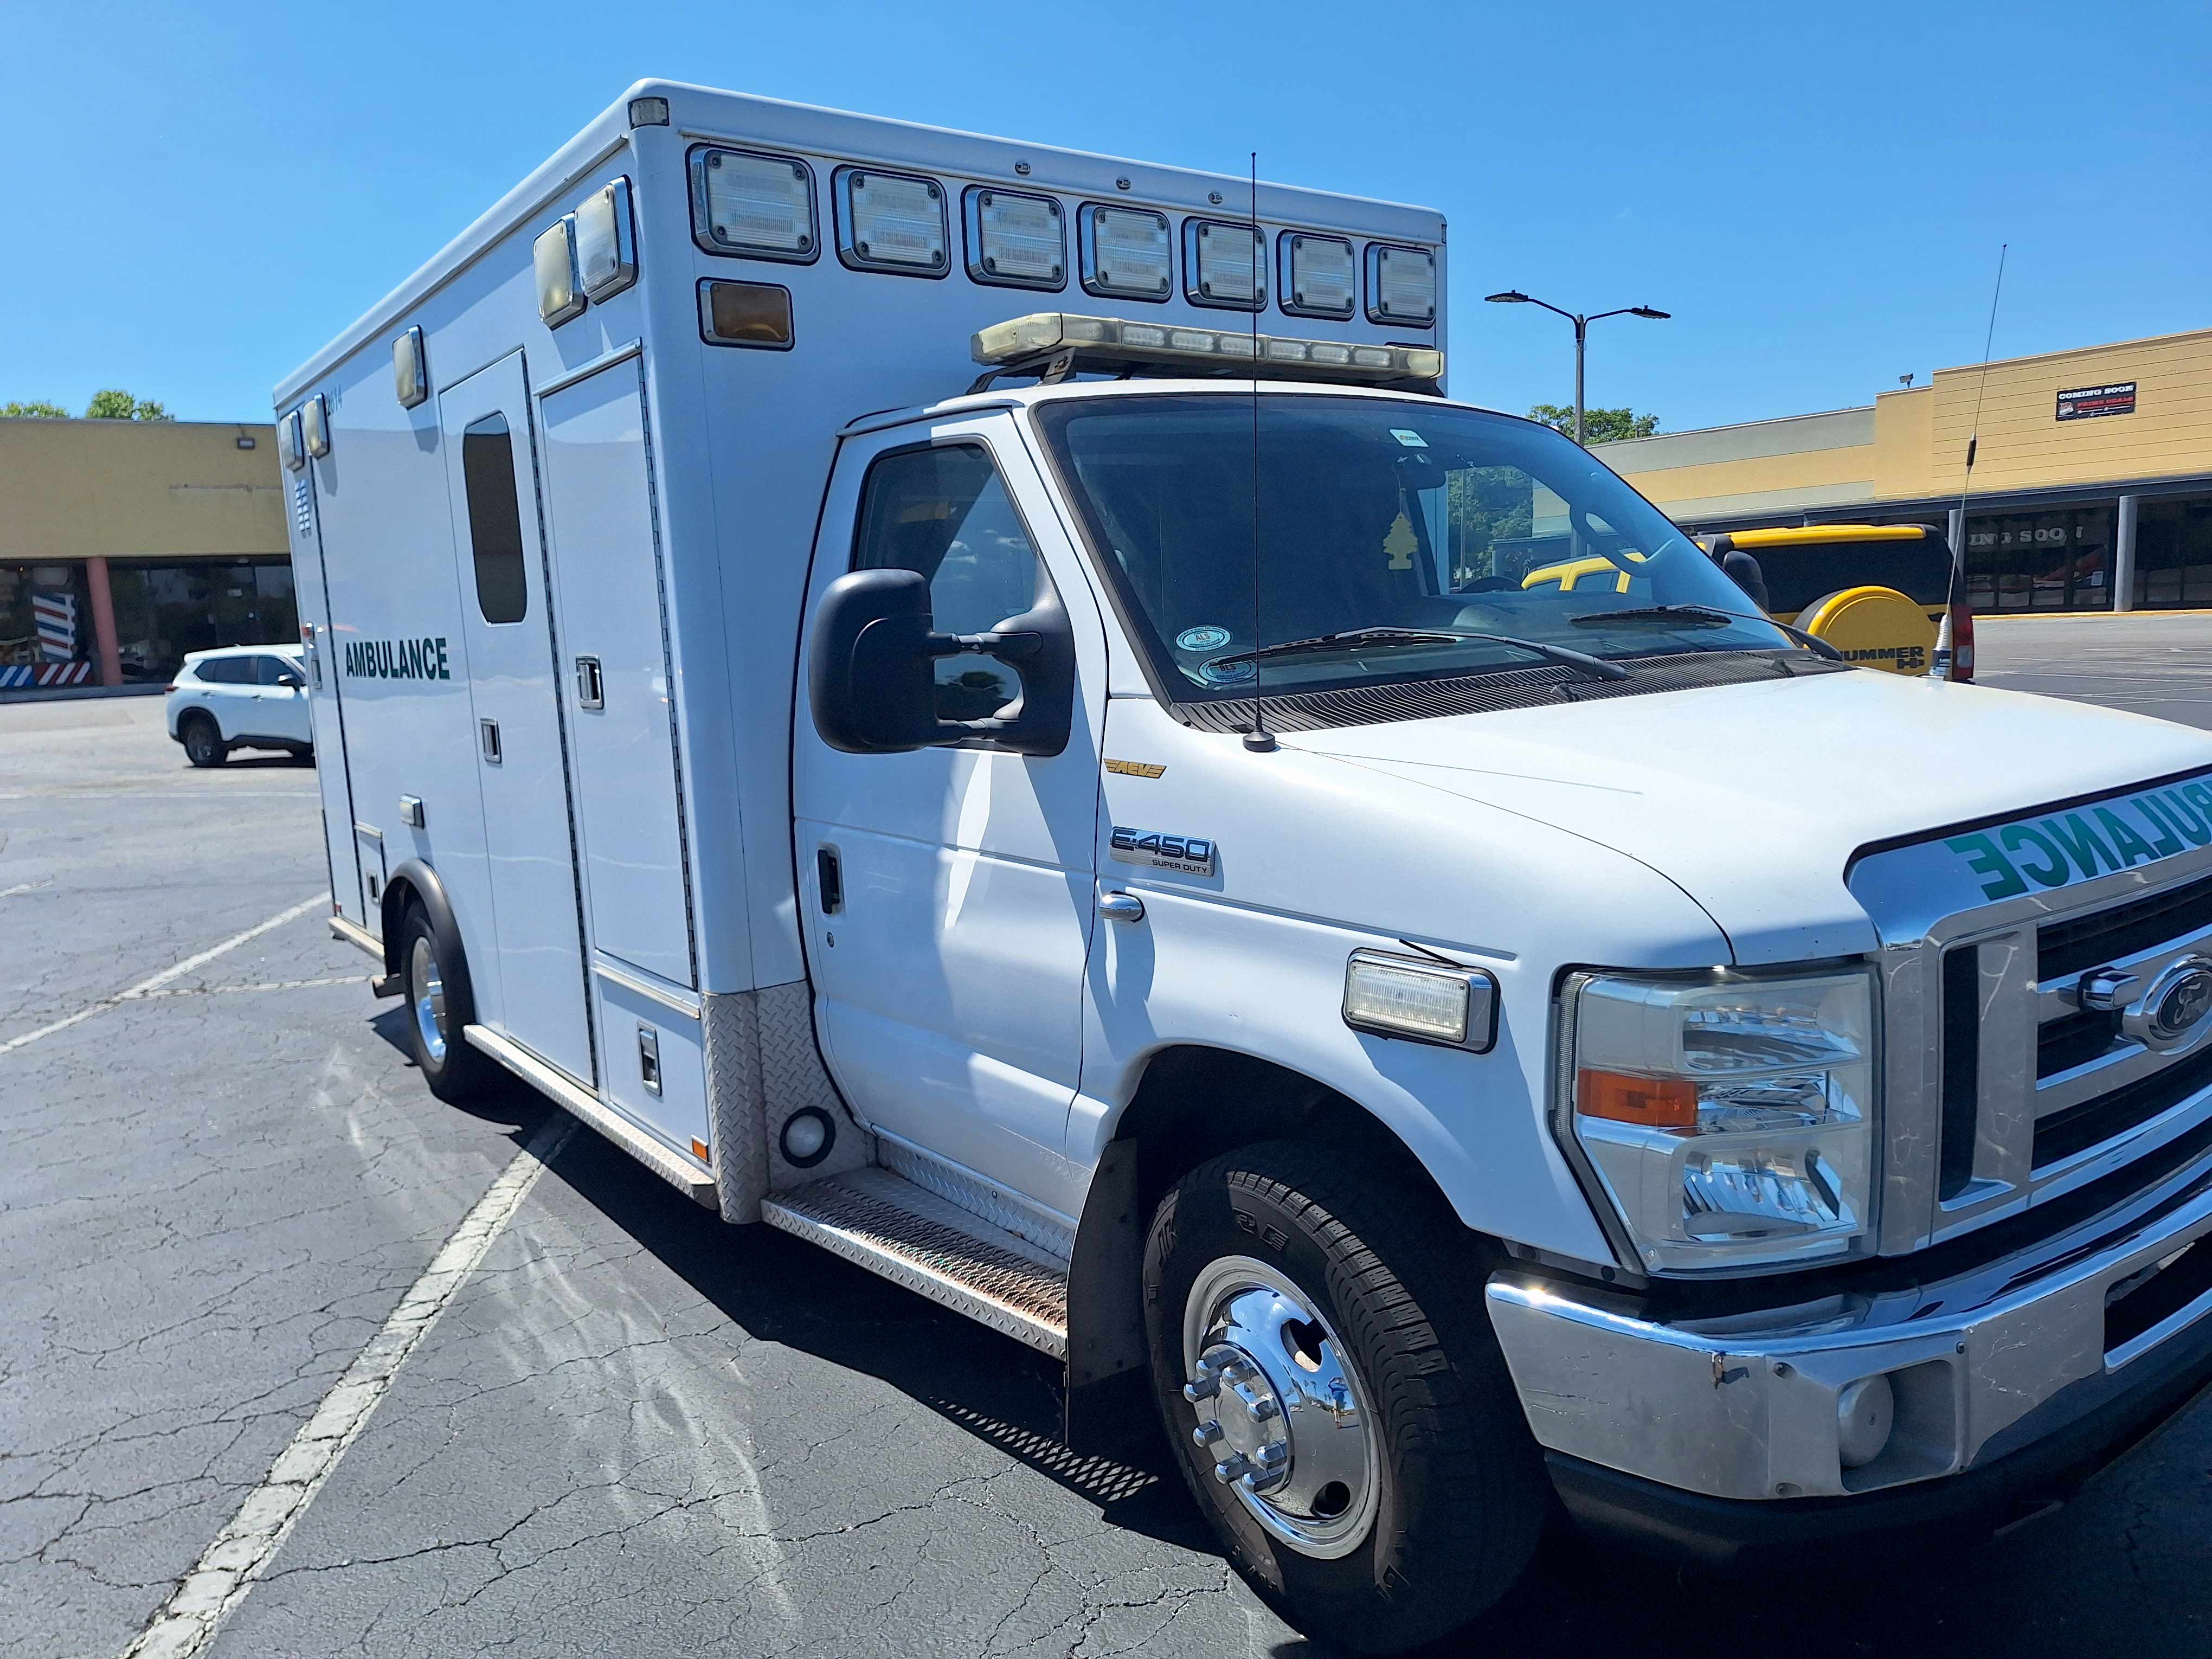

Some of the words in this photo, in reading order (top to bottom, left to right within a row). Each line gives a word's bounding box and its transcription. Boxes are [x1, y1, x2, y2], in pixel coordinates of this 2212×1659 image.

[2059, 389, 2102, 400] COMING
[2104, 385, 2134, 394] SOON
[1196, 633, 1211, 641] ALS
[345, 638, 450, 680] AMBULANCE
[1152, 859, 1181, 870] SUPER
[1184, 864, 1207, 873] DUTY
